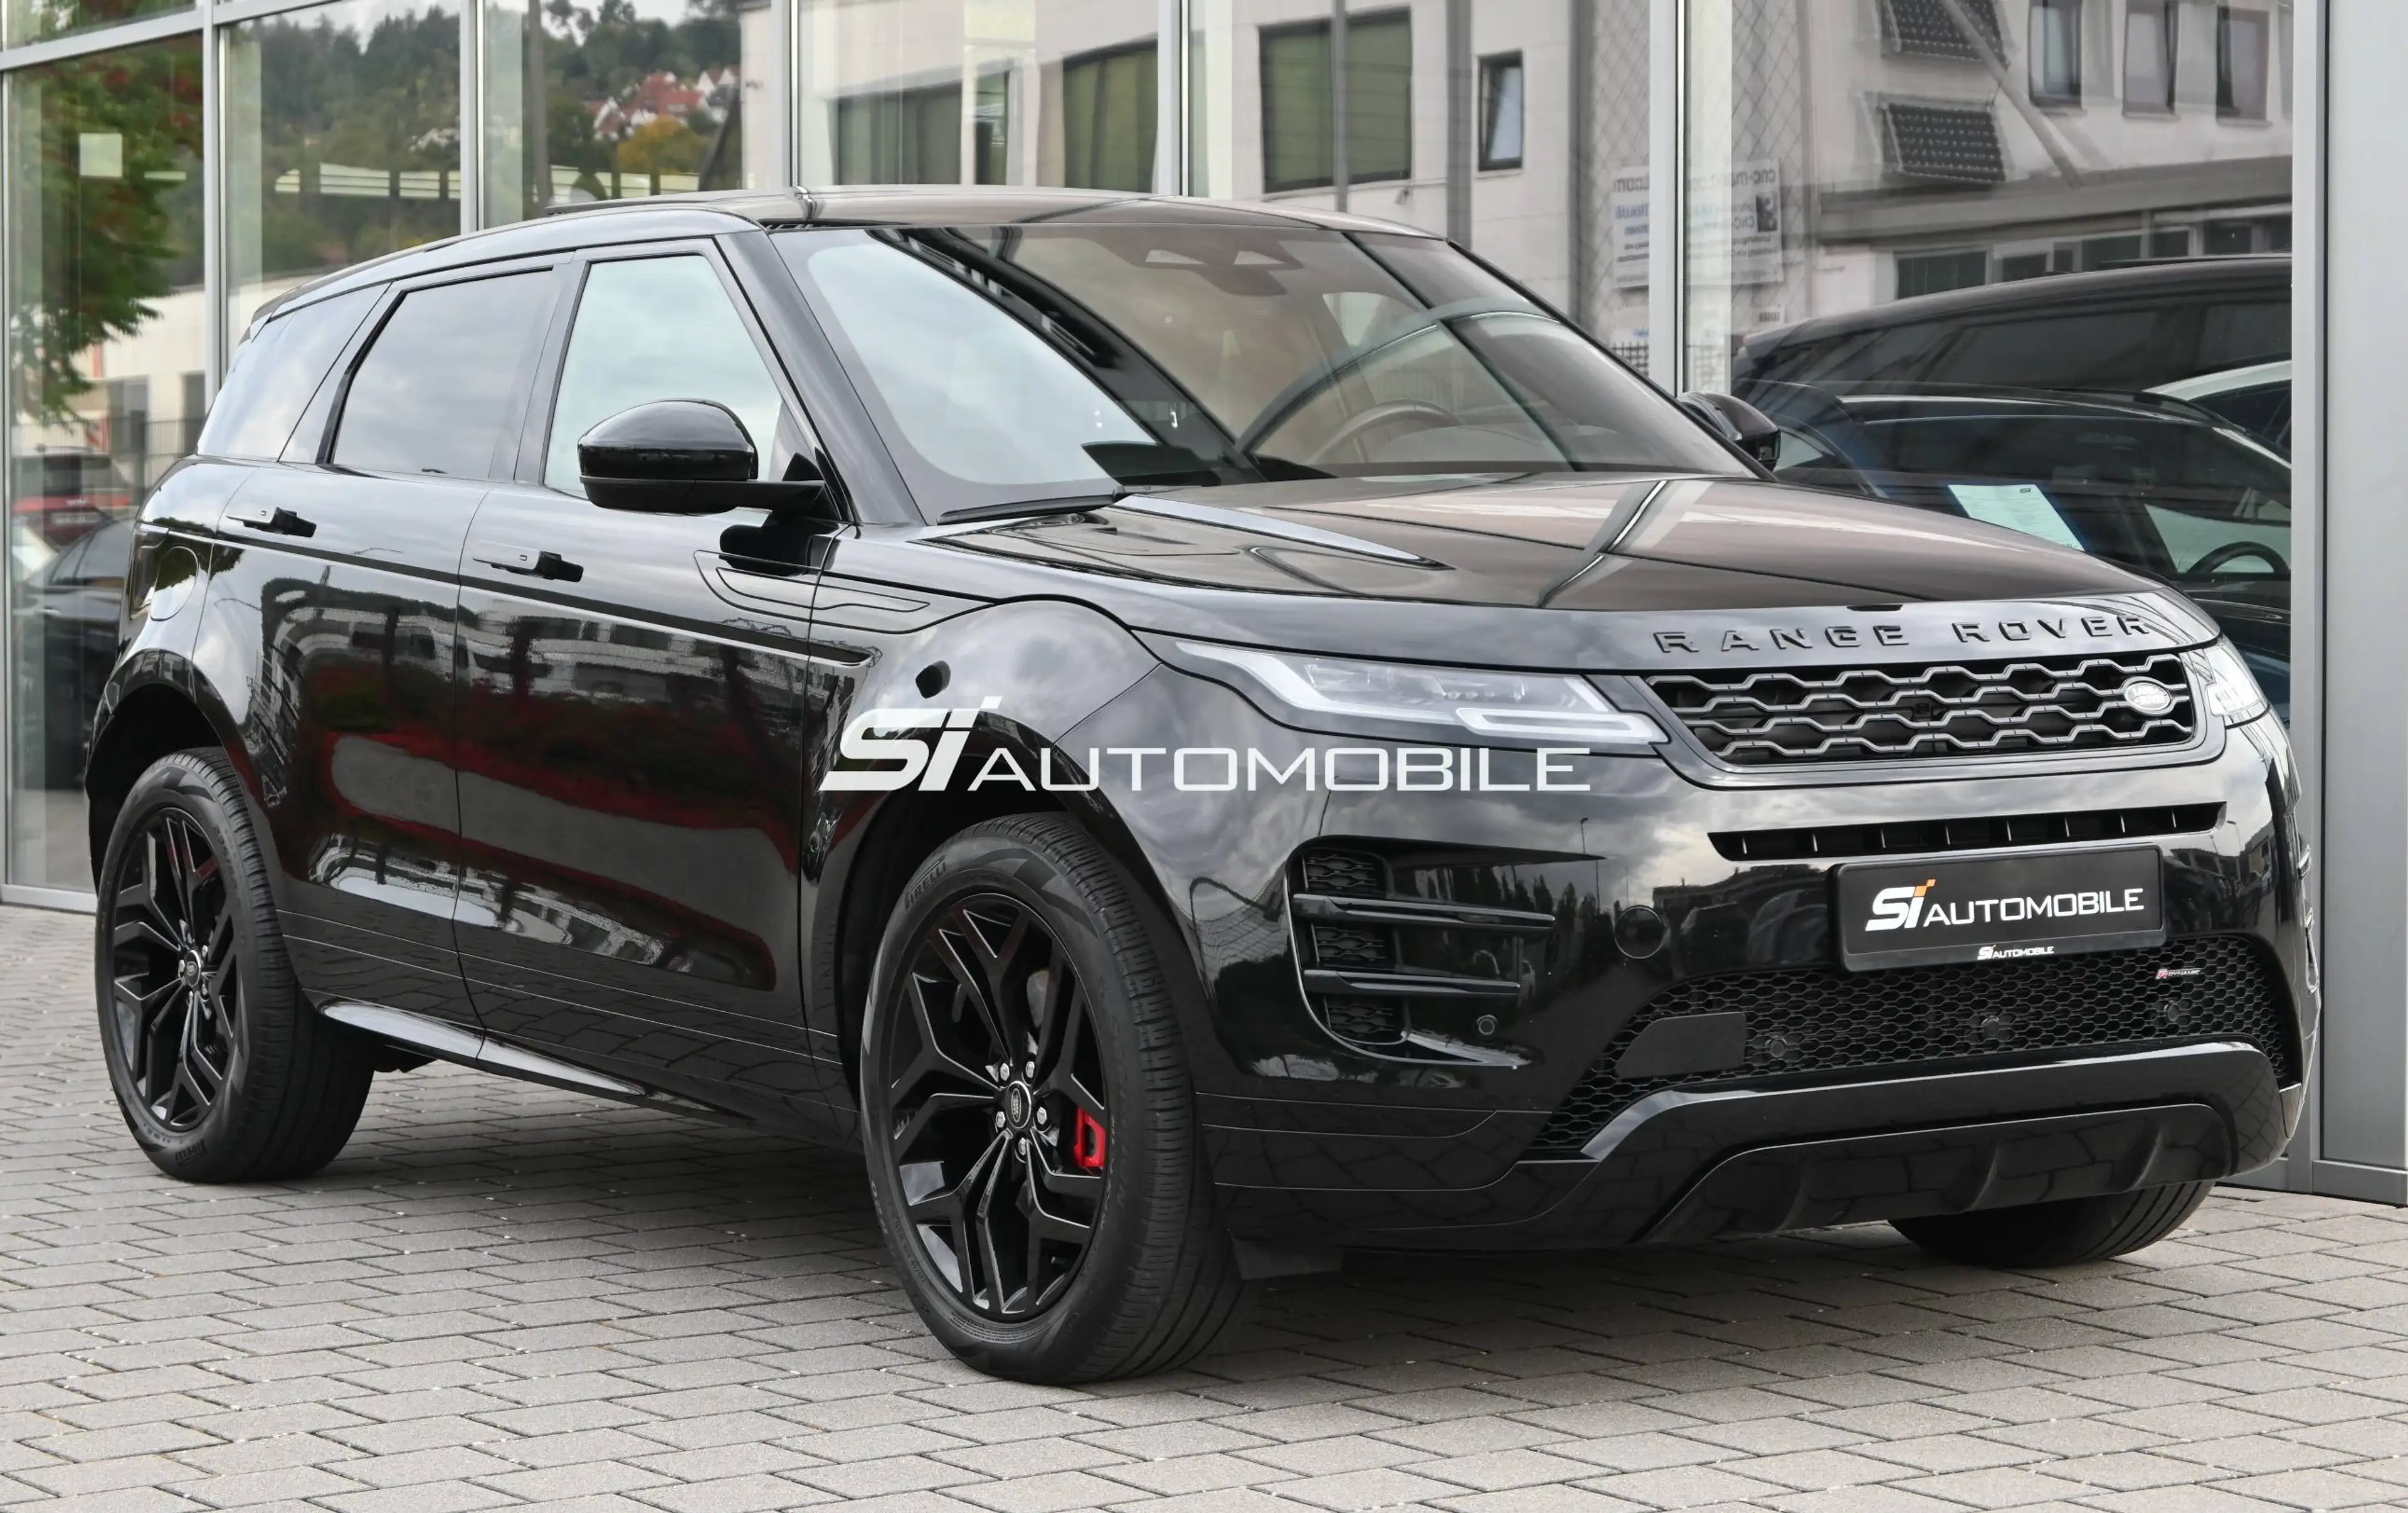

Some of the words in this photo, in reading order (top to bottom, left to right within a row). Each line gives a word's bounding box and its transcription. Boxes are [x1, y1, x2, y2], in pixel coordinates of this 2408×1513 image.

[1654, 625, 1909, 653] RANGE
[1951, 615, 2150, 642] ROVER
[904, 854, 947, 911] PIRELLI
[1923, 888, 2145, 928] AUTOMOBILE
[1992, 945, 2054, 959] AUTOMOBILE
